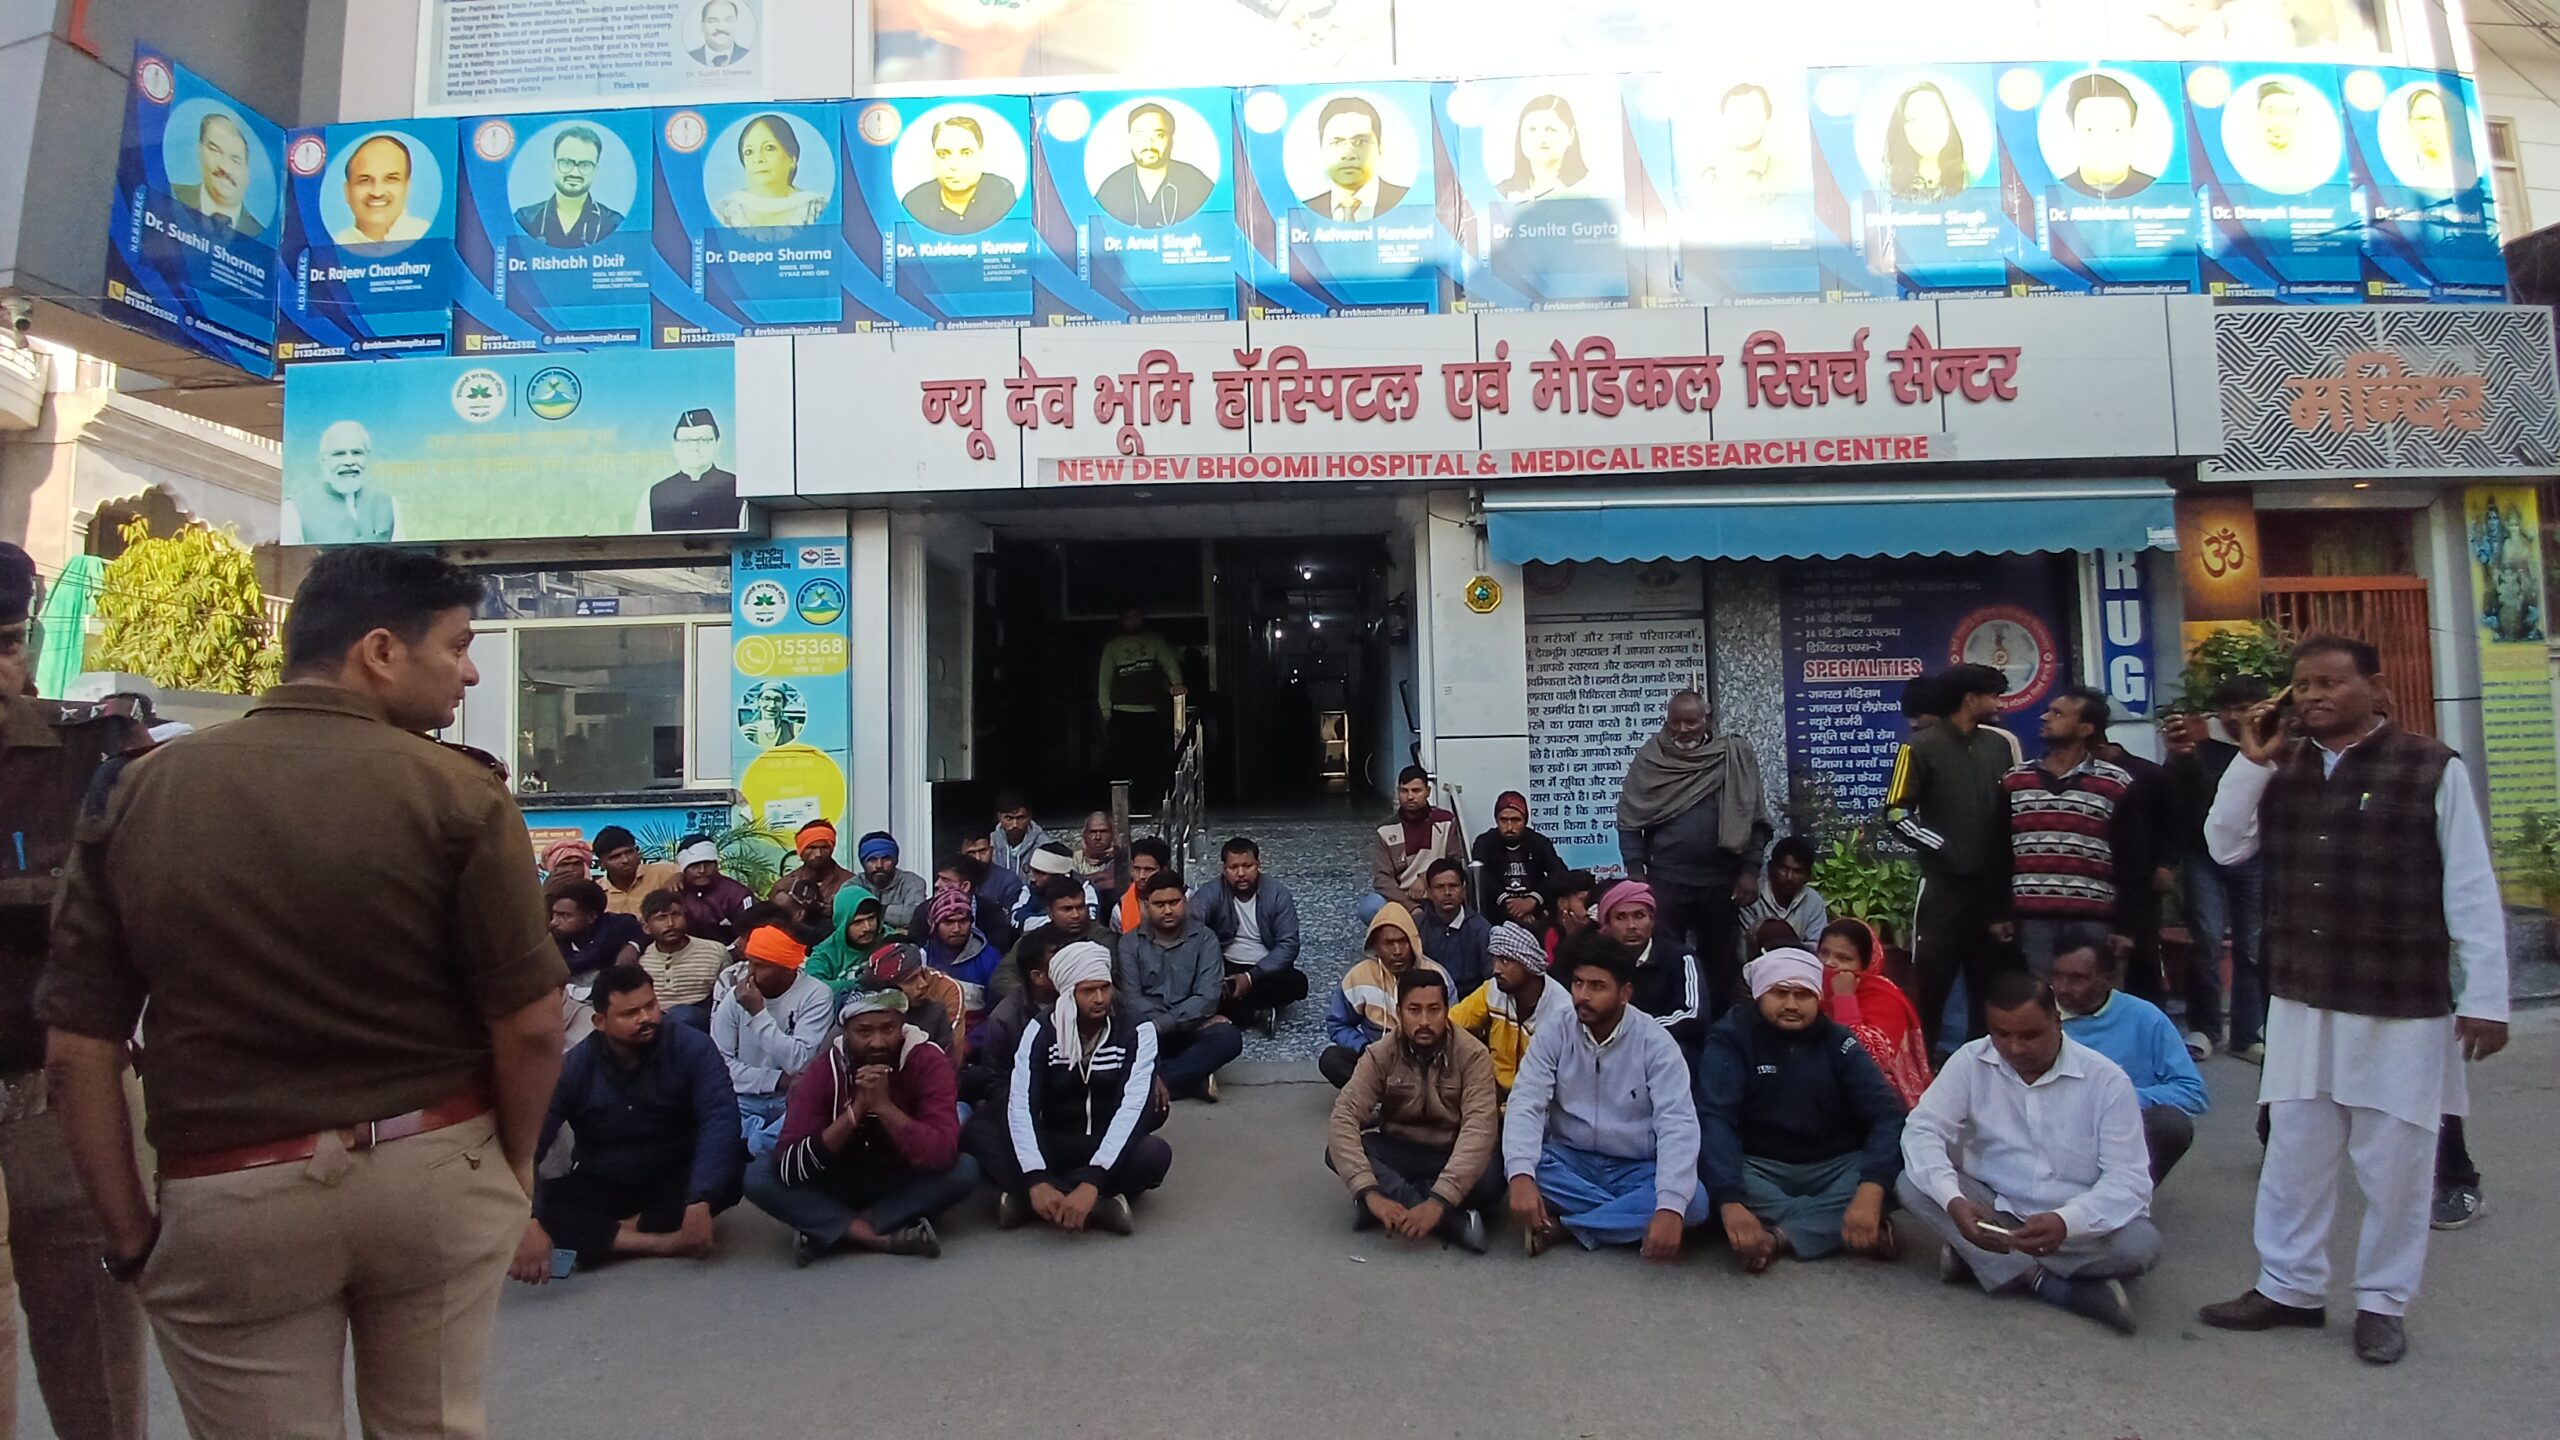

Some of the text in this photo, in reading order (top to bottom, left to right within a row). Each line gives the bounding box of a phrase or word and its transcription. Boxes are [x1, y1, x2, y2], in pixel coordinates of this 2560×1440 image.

[2049, 208, 2067, 221] Dr.
[2213, 207, 2232, 219] Dr.
[1291, 229, 1310, 243] Dr.
[1494, 222, 1618, 239] Dr. Sunita Gupta
[145, 212, 164, 233] Dr.
[168, 223, 209, 253] Sushil
[214, 244, 265, 280] Sharma
[897, 241, 1028, 258] Dr. Kuldeep Kumar
[1104, 233, 1202, 253] Dr. Anuj Singh
[509, 254, 625, 271] Dr. Rishabh Dixit
[706, 248, 832, 265] Dr. Deepa Sharma
[310, 262, 431, 282] Dr. Rajeev Chaudhary
[1340, 307, 1425, 317] devbhoomihospital.com
[1543, 301, 1628, 311] devbhoomihospital.com
[947, 320, 1030, 330] devbhoomihospital.com
[1141, 314, 1225, 324] devbhoomihospital.com
[554, 334, 637, 343] devbhoomihospital.com
[921, 325, 2022, 460] न्यू देव भूमि हॉस्पिटल एवं मेडिकल रिसर्च सैन्टर
[1058, 436, 1928, 481] NEW DEV BHOOMI HOSPITAL & MEDICAL RESEARCH CENTRE
[1583, 631, 1603, 642] और
[1609, 630, 1633, 641] उनके
[775, 638, 842, 655] 155368
[1570, 647, 1609, 657] अस्पताल
[1613, 644, 1621, 655] में
[1625, 646, 1654, 655] आपका
[1659, 645, 1688, 654] स्वागत
[1537, 661, 1565, 671] आपके
[1603, 660, 1620, 670] और
[1623, 661, 1655, 670] कल्याण
[1658, 659, 1671, 669] को
[1805, 659, 1923, 678] SPECIALITIES
[1568, 676, 1581, 685] देते
[1621, 673, 1637, 685] टीम
[1639, 673, 1666, 684] आपके
[1668, 672, 1685, 683] लिए
[1556, 688, 1668, 700] वाली चिकित्सा प्रदान
[1543, 702, 1575, 715] समर्पित
[1592, 704, 1606, 714] हम
[1610, 702, 1640, 714] आपकी
[1644, 703, 1656, 713] हर
[1846, 701, 1861, 713] एवं
[1550, 720, 1563, 729] का
[1568, 719, 1593, 730] प्रयास
[1598, 717, 1620, 728] करते
[1834, 716, 1863, 727] सर्जरी
[1544, 731, 1644, 746] उपकरण आधुनिक और
[1809, 730, 1838, 745] प्रसूति
[1839, 729, 1855, 741] एवं
[1877, 729, 1895, 740] रोग
[1556, 745, 1611, 758] ताकि आपको
[1810, 744, 1848, 755] नवजात
[1873, 742, 1888, 754] एवं
[1573, 763, 1587, 772] हम
[1592, 760, 1622, 771] आपको
[1811, 758, 1843, 769] दिमाग
[1548, 775, 1606, 790] में सूचित और
[1857, 771, 1882, 783] केयर
[1553, 791, 1575, 801] करते
[1543, 805, 1559, 816] गर्व
[1576, 805, 1589, 815] कि
[1564, 819, 1586, 830] किया
[1574, 834, 1595, 844] करते
